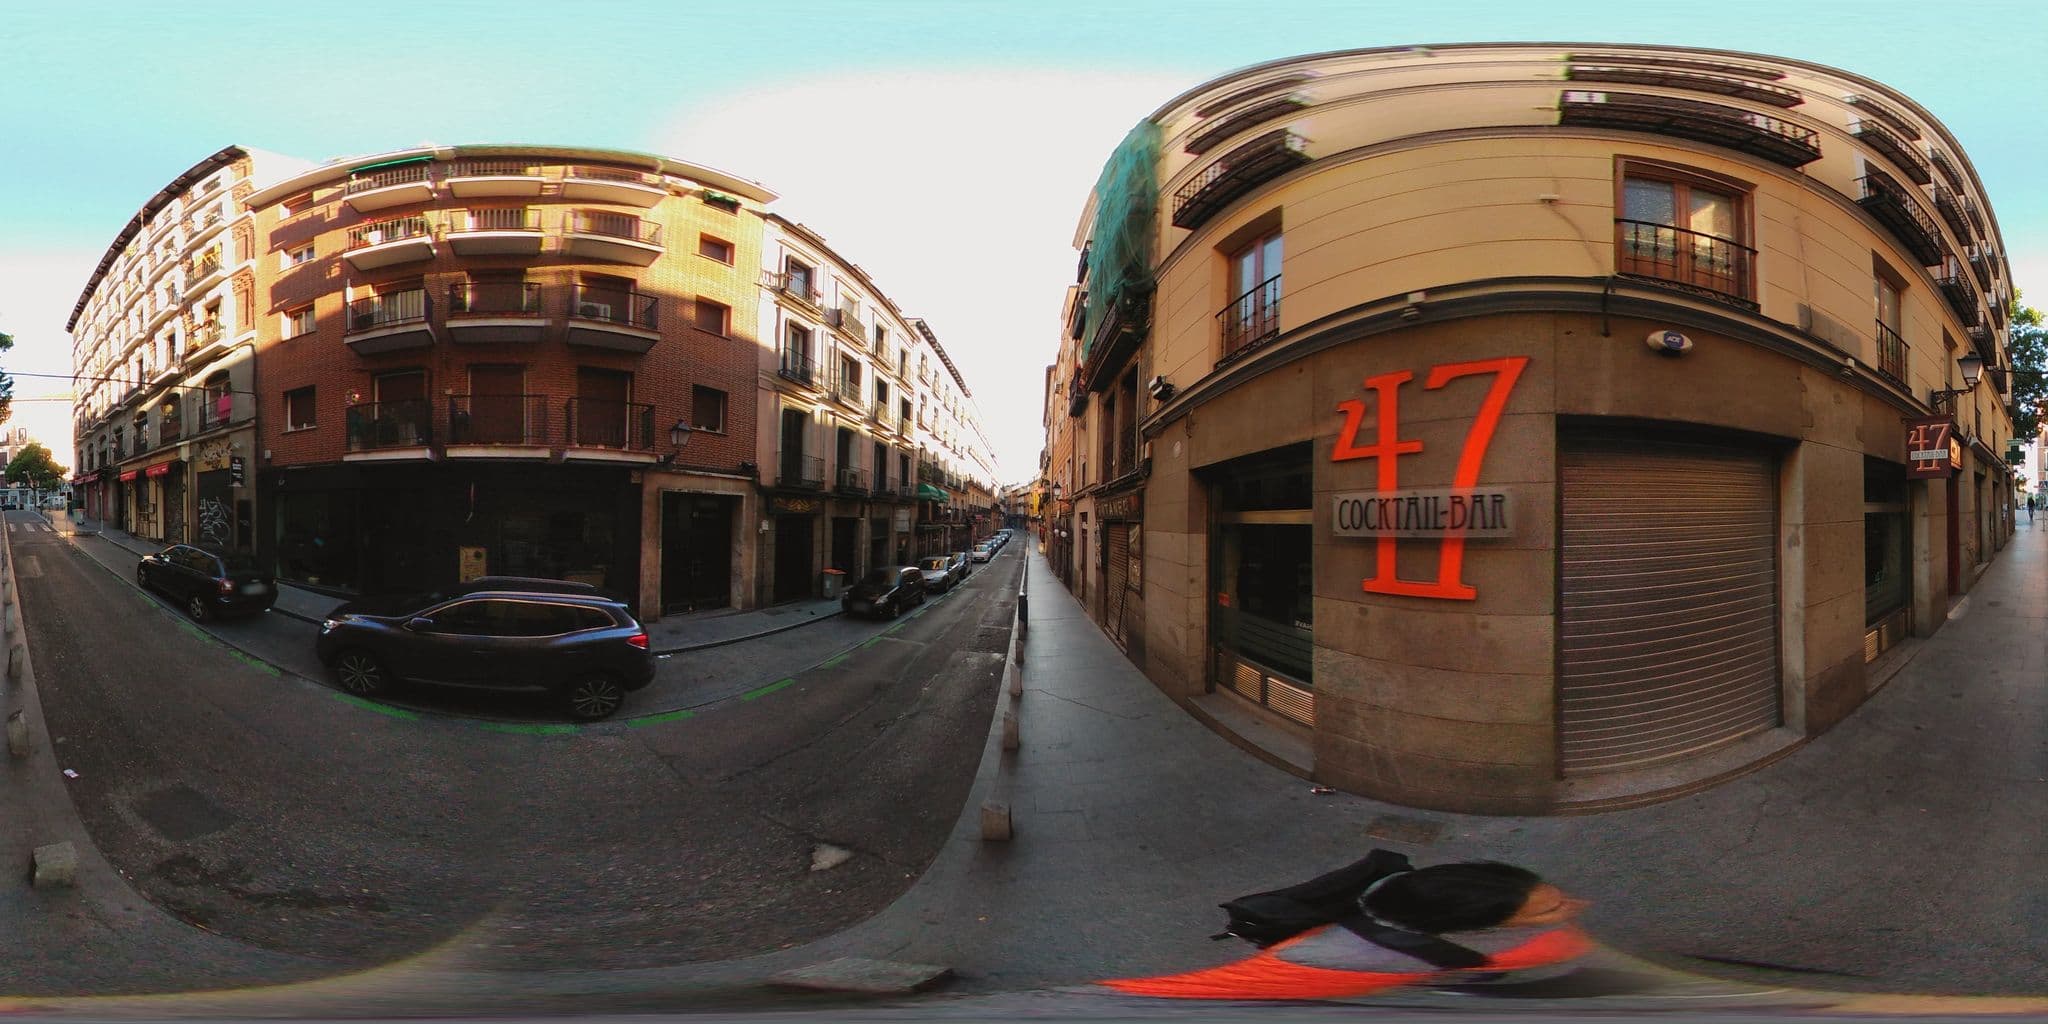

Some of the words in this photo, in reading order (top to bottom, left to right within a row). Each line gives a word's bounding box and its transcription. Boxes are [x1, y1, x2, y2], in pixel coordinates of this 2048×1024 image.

[1908, 423, 1951, 471] 47
[1331, 356, 1531, 600] 47
[1338, 494, 1508, 531] COCKTAIL-BAR
